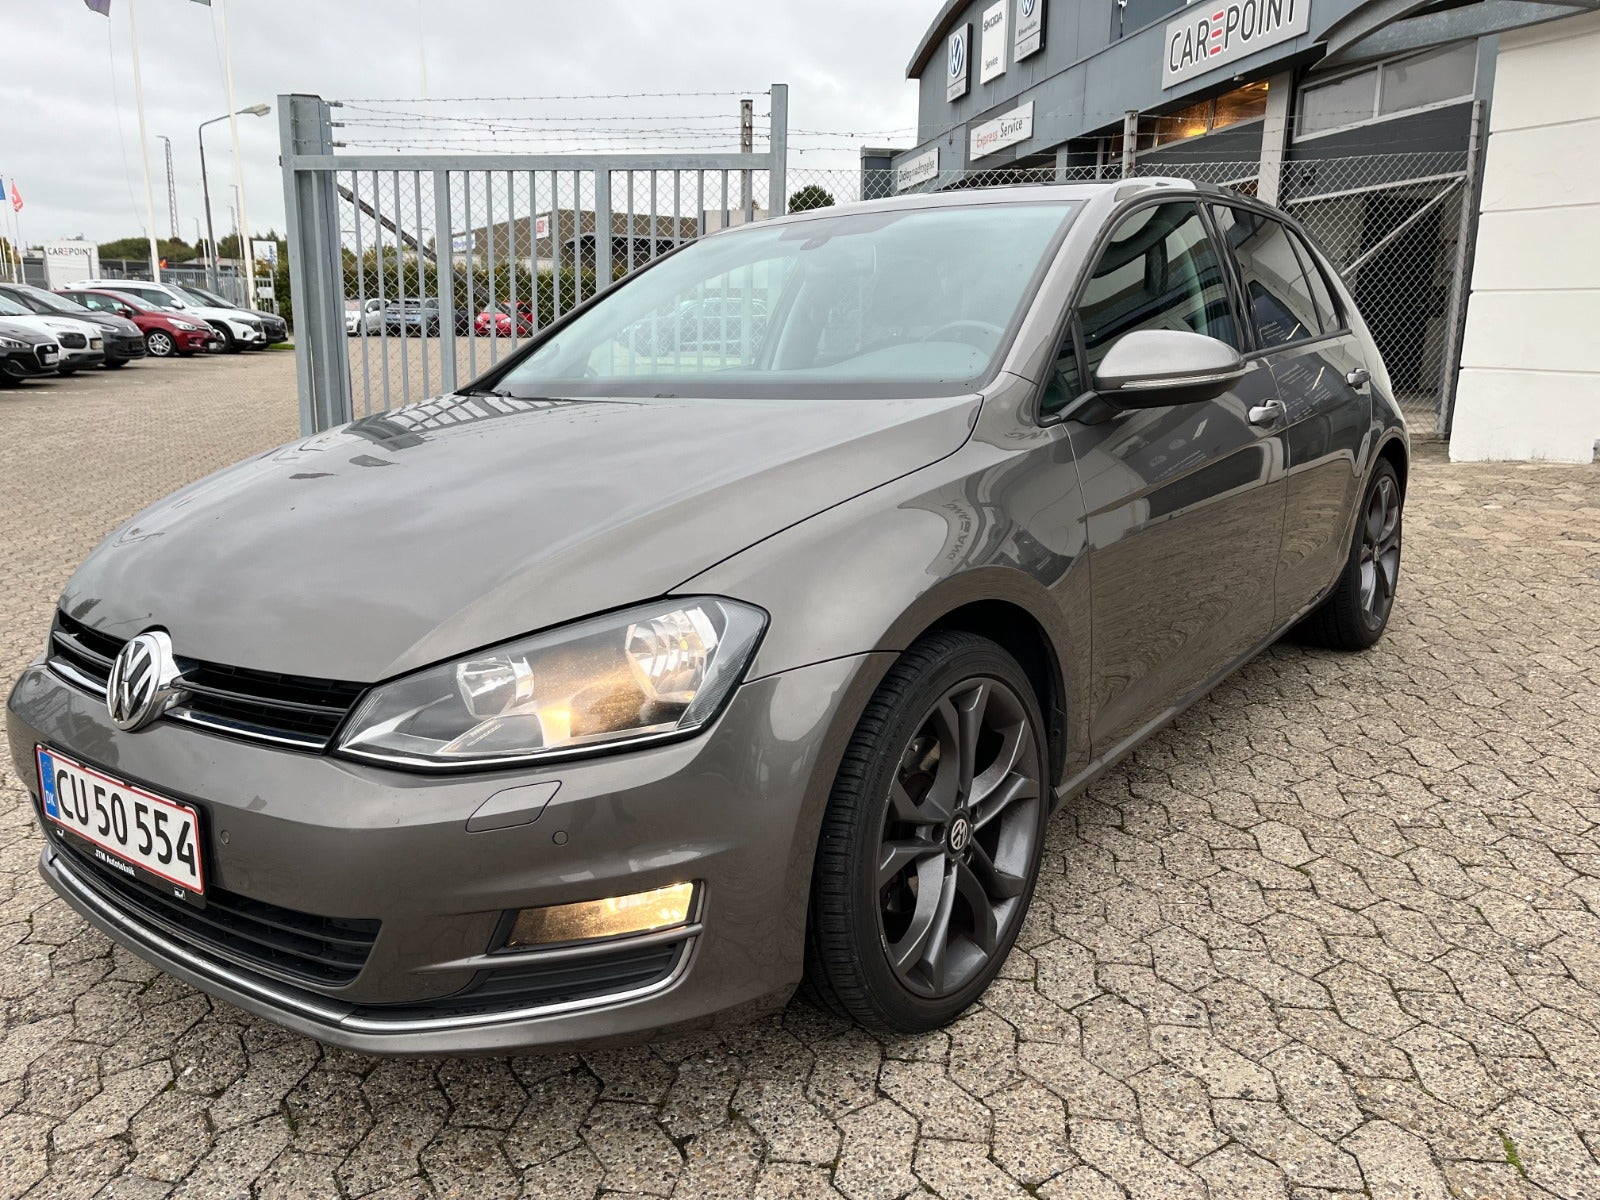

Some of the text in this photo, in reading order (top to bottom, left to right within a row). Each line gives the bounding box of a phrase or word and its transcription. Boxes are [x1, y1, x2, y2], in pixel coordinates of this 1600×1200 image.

[976, 119, 1023, 149] Express Service
[47, 247, 92, 256] CAREPOINT
[45, 790, 55, 806] DK
[56, 769, 196, 877] CU 50 554
